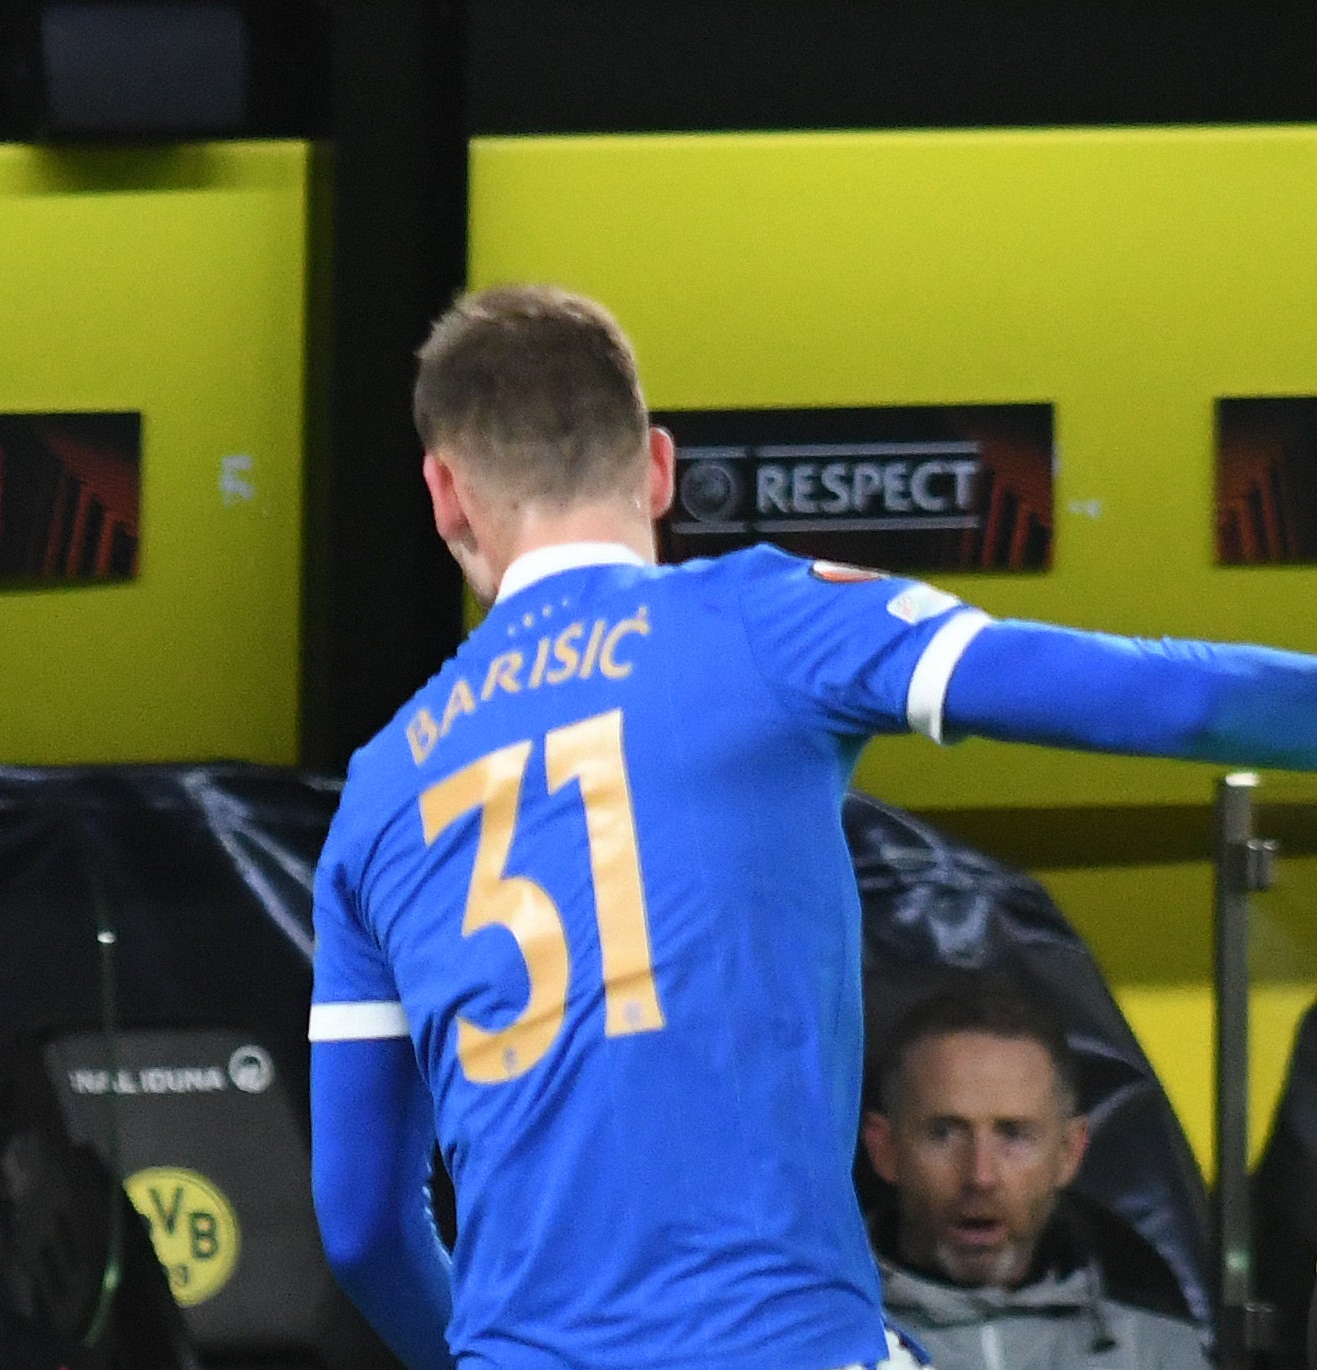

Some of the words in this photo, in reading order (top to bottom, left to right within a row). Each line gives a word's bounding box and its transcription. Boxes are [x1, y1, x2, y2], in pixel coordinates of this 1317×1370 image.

[756, 459, 979, 515] RESPECT
[419, 708, 666, 1084] 31
[148, 1187, 218, 1260] VB
